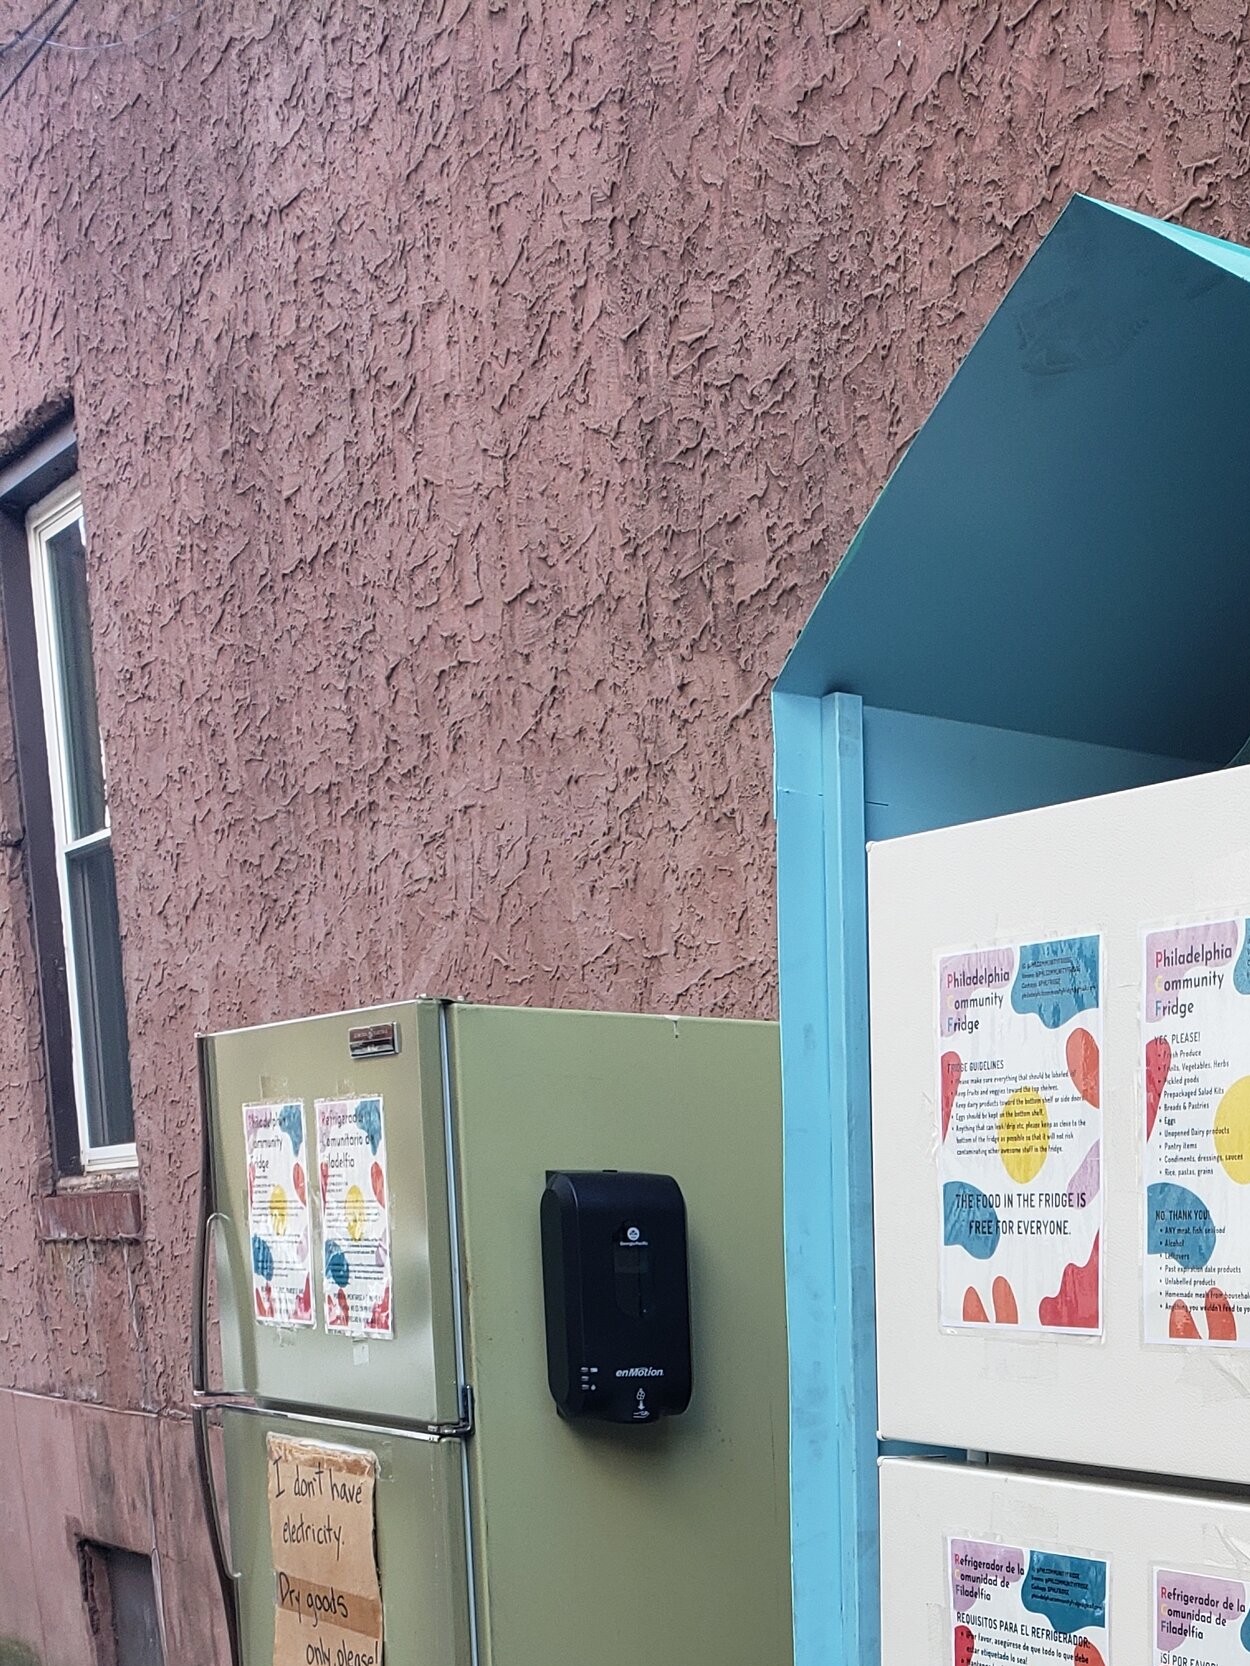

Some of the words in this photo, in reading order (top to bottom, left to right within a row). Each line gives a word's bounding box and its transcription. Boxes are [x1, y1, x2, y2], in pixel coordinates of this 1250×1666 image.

[1156, 943, 1232, 968] Philadelphia
[947, 967, 1010, 988] Philadelphia
[1155, 971, 1224, 993] Community
[947, 994, 1004, 1009] Community
[1156, 998, 1194, 1018] Fridge
[947, 1015, 980, 1034] Fridge
[1172, 1032, 1200, 1044] PLEASE!
[969, 1060, 1004, 1071] GUIDELINES
[1213, 1060, 1229, 1068] Herbs
[1184, 1076, 1199, 1085] goods
[1164, 1090, 1197, 1100] Prepackaged
[1198, 1088, 1213, 1096] Salad
[1164, 1117, 1176, 1126] Eggs
[1165, 1130, 1189, 1138] Unopened
[1191, 1128, 1204, 1137] Dairy
[1206, 1127, 1230, 1136] products
[1165, 1143, 1182, 1152] Pantry
[1197, 1167, 1213, 1176] grains
[956, 1194, 973, 1208] THE
[977, 1194, 1001, 1208] FOOD
[1004, 1194, 1013, 1208] IN
[1017, 1194, 1035, 1207] THE
[1039, 1193, 1074, 1207] FRIDGE
[1077, 1193, 1086, 1207] IS
[1169, 1210, 1192, 1220] THANK
[969, 1221, 993, 1235] FREE
[996, 1220, 1014, 1235] FOR
[1018, 1220, 1071, 1235] EVERYONE.
[1217, 1266, 1241, 1275] products
[1194, 1279, 1216, 1287] products
[273, 1456, 285, 1498] I
[294, 1462, 324, 1498] don't
[329, 1468, 362, 1504] have
[283, 1513, 345, 1561] electricity.
[955, 1554, 1003, 1572] Refrigerador
[1006, 1563, 1015, 1574] de
[1017, 1566, 1025, 1575] la
[955, 1569, 997, 1586] Comunidad
[1001, 1579, 1010, 1588] de
[279, 1572, 301, 1623] Dry
[307, 1587, 348, 1627] goods
[956, 1585, 991, 1601] Filadelfia
[1161, 1587, 1220, 1608] Refrigerador
[1223, 1597, 1234, 1610] de
[1237, 1600, 1246, 1612] la
[1160, 1603, 1212, 1624] Comunidad
[1216, 1614, 1227, 1626] de
[957, 1612, 997, 1629] REQUISITOS
[1000, 1621, 1018, 1634] PARA
[1021, 1625, 1029, 1637] EL
[1032, 1627, 1091, 1648] REFRIGERADOR:
[1161, 1621, 1204, 1639] Filadelfia
[1031, 1645, 1041, 1653] que
[1042, 1646, 1055, 1656] todo
[1064, 1652, 1073, 1661] que
[1075, 1653, 1088, 1664] debe
